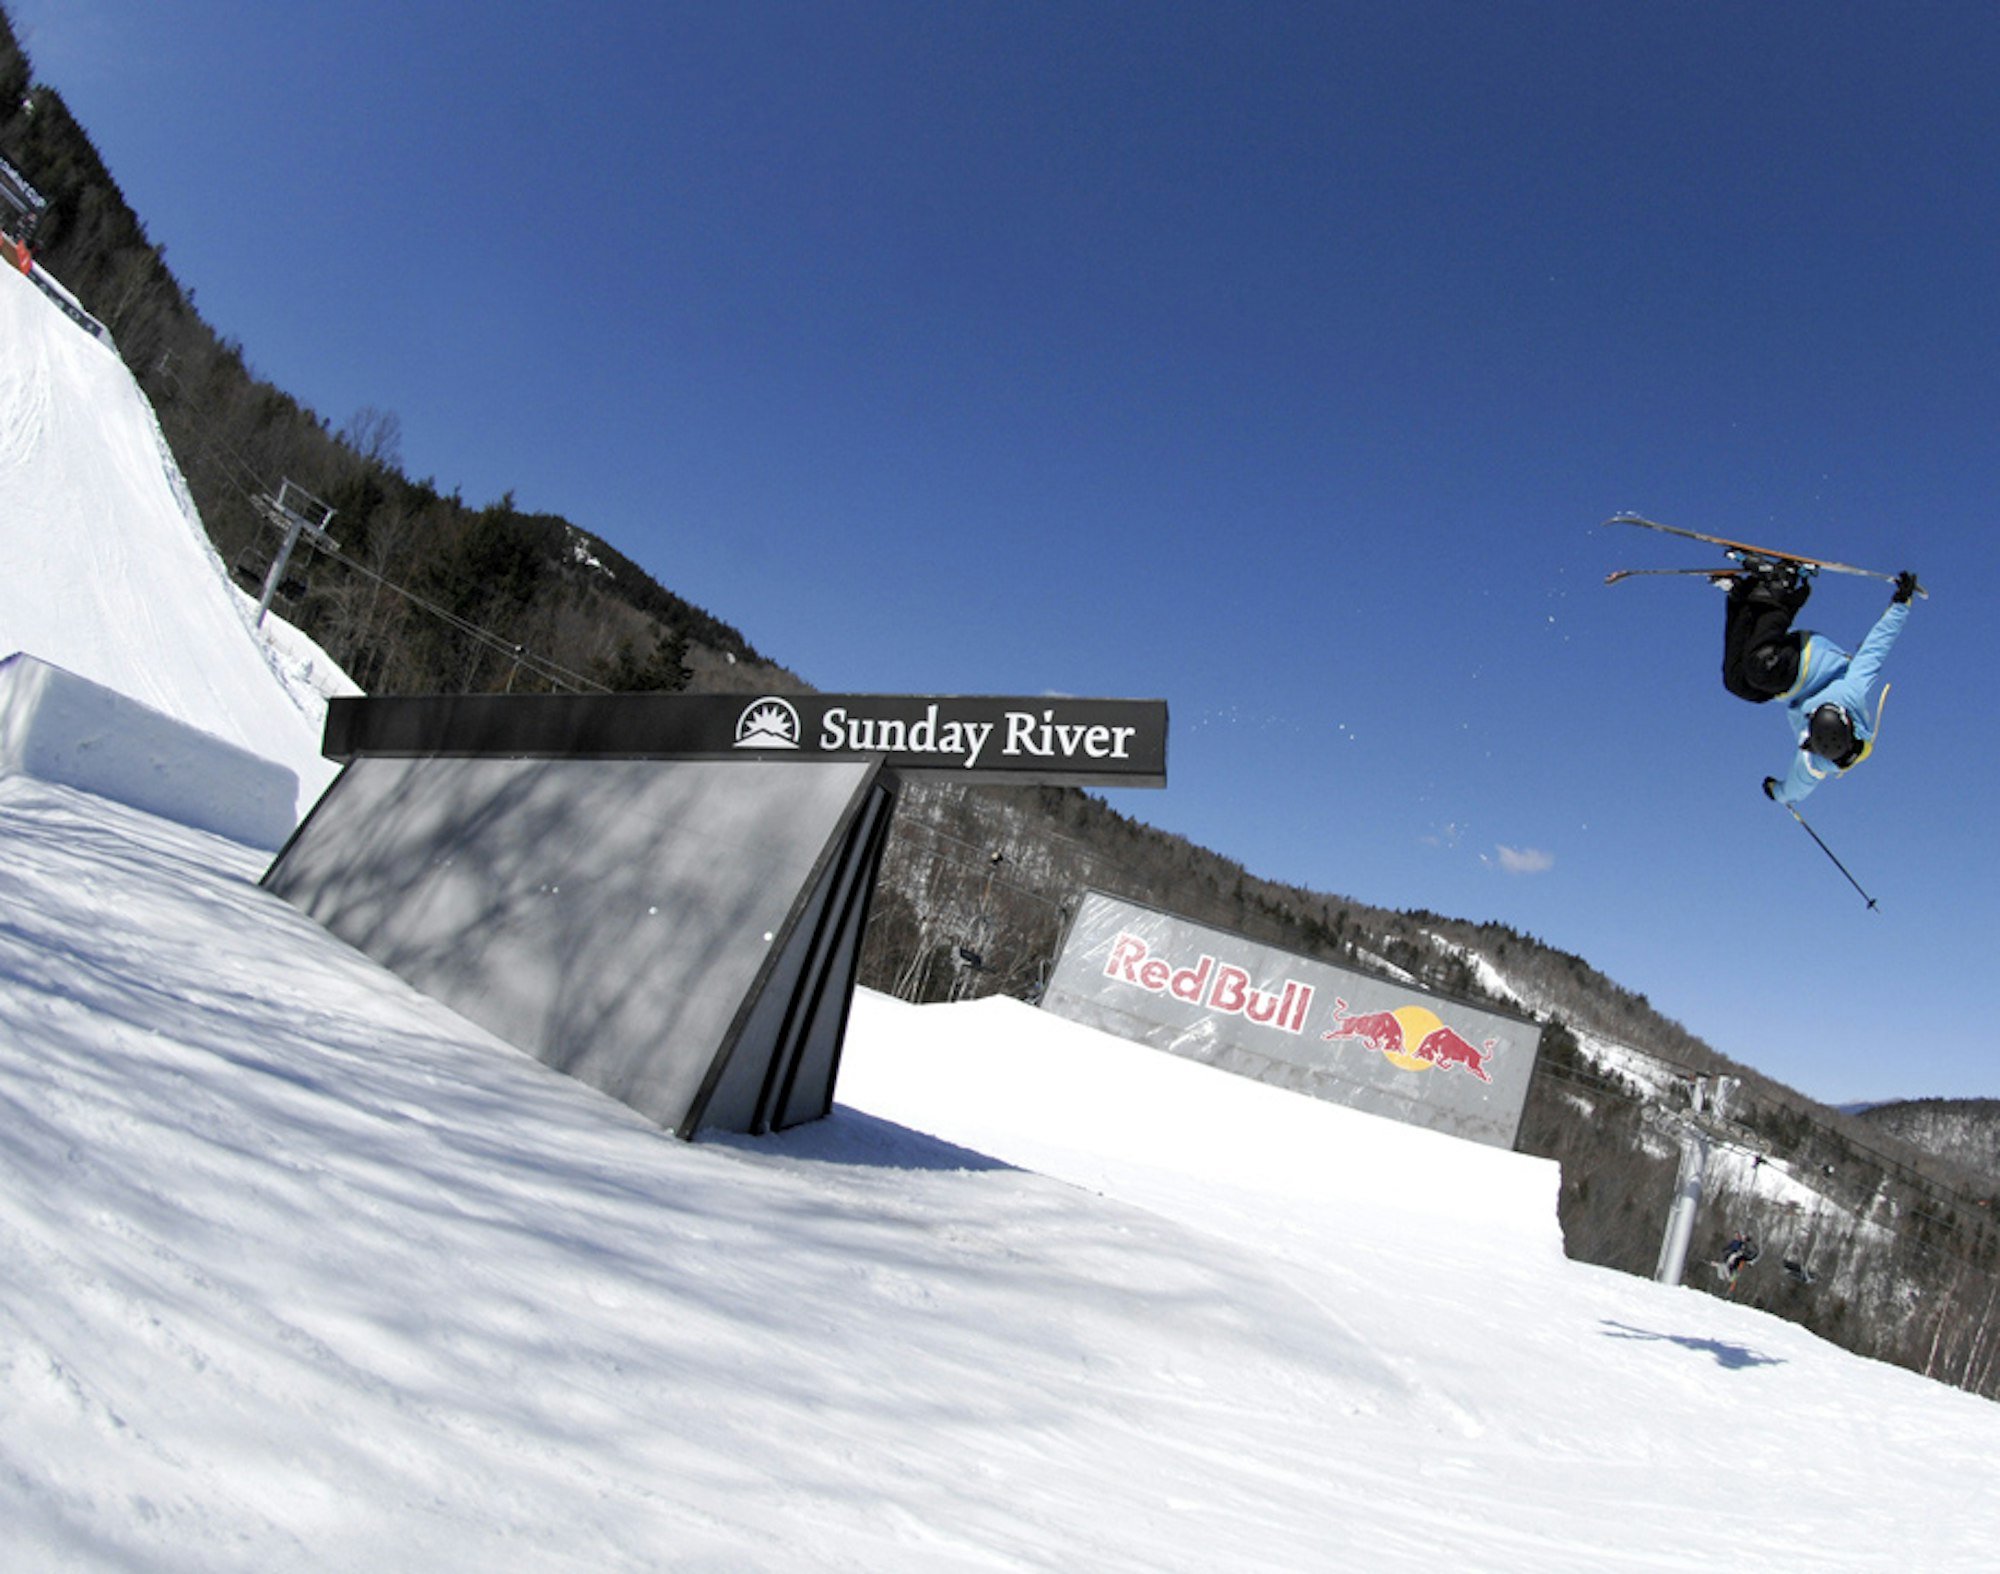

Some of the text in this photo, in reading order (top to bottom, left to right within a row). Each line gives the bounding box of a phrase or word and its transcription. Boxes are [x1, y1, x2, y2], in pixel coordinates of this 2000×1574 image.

[819, 704, 1136, 769] Sunday River
[1105, 932, 1315, 1034] Red Bull
